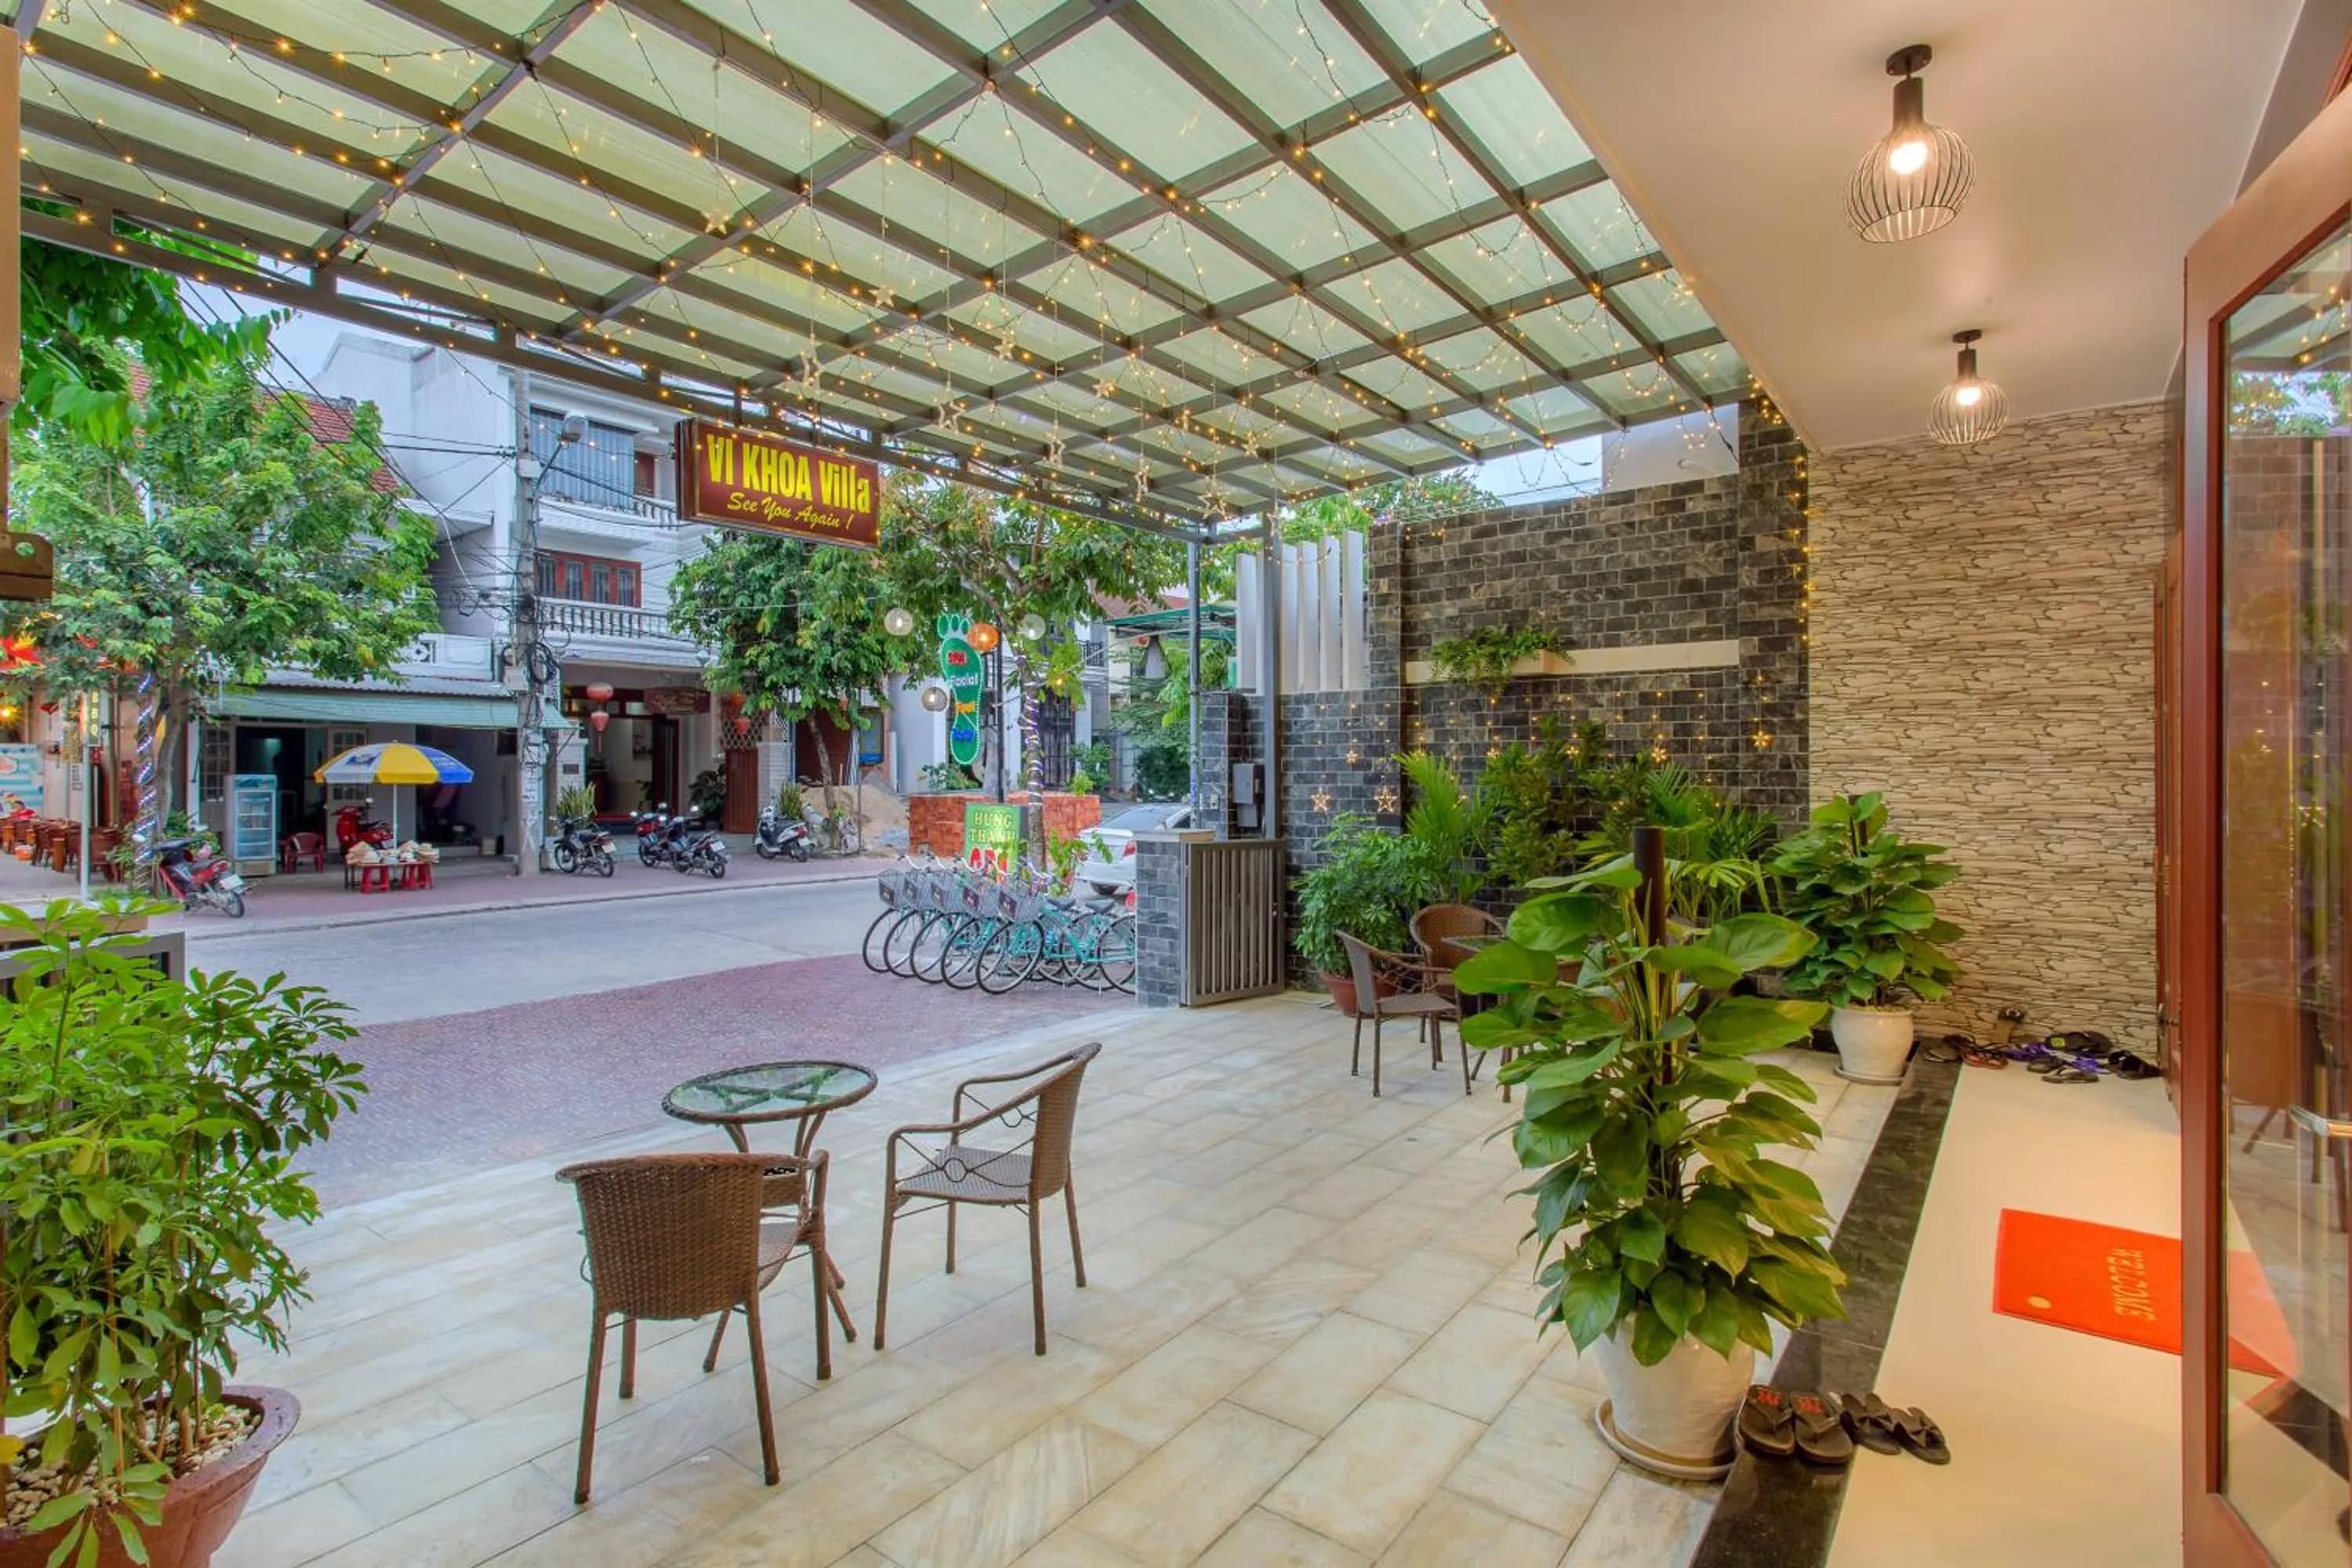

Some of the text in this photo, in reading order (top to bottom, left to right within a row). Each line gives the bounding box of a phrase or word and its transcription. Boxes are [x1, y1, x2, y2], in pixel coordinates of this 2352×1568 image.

[706, 434, 870, 514] VI KHOA Villa
[728, 492, 757, 513] See
[761, 496, 792, 521] You
[794, 506, 840, 528] Again
